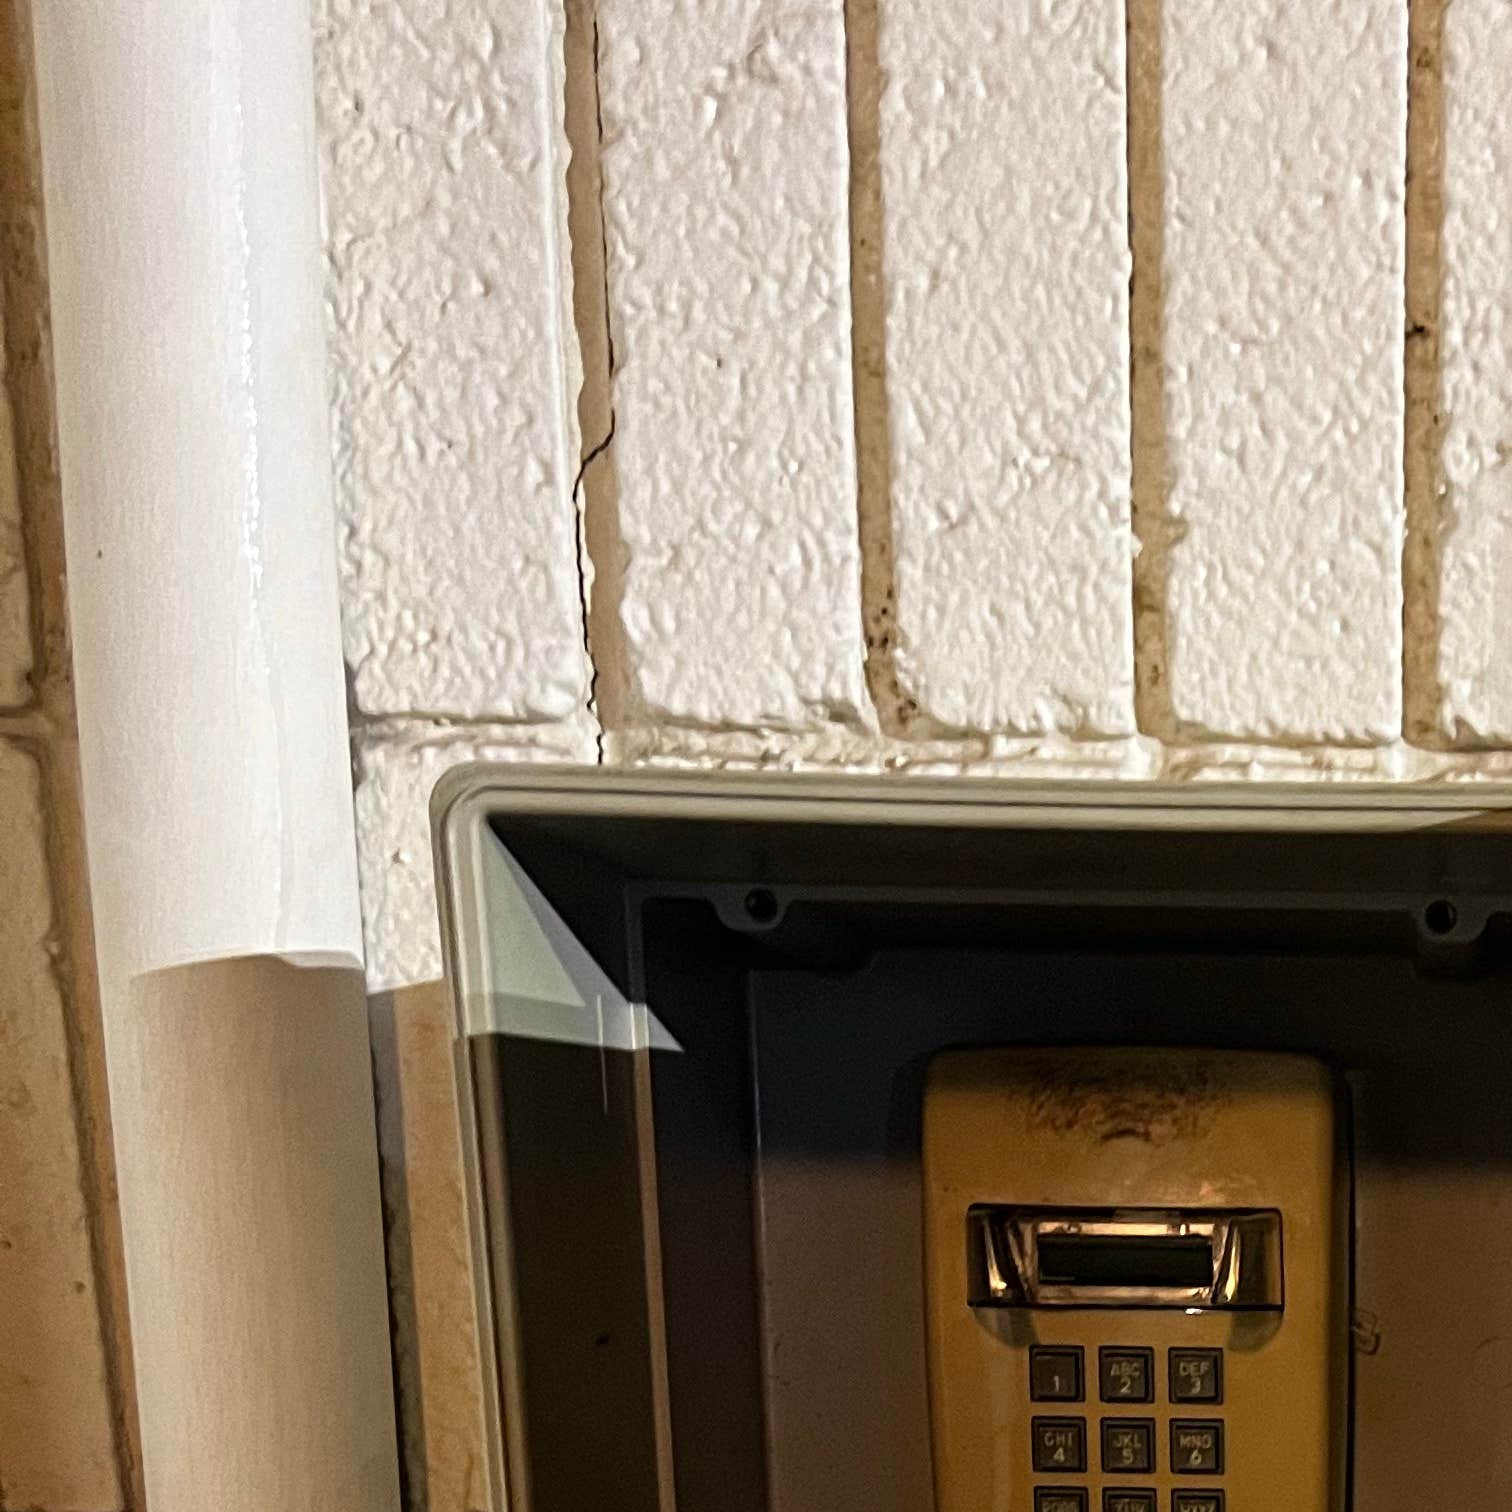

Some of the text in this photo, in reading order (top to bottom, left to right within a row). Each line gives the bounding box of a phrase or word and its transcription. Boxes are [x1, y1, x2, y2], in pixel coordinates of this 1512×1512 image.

[1110, 1362, 1140, 1377] ABC
[1179, 1362, 1209, 1377] DEF
[1053, 1375, 1061, 1393] 1
[1120, 1377, 1132, 1394] 2
[1191, 1377, 1202, 1394] 3
[1044, 1432, 1073, 1447] GHI
[1113, 1434, 1142, 1449] JKL
[1179, 1434, 1212, 1449] MNO
[1053, 1447, 1066, 1464] 4
[1122, 1449, 1134, 1465] 5
[1190, 1449, 1202, 1466] 6
